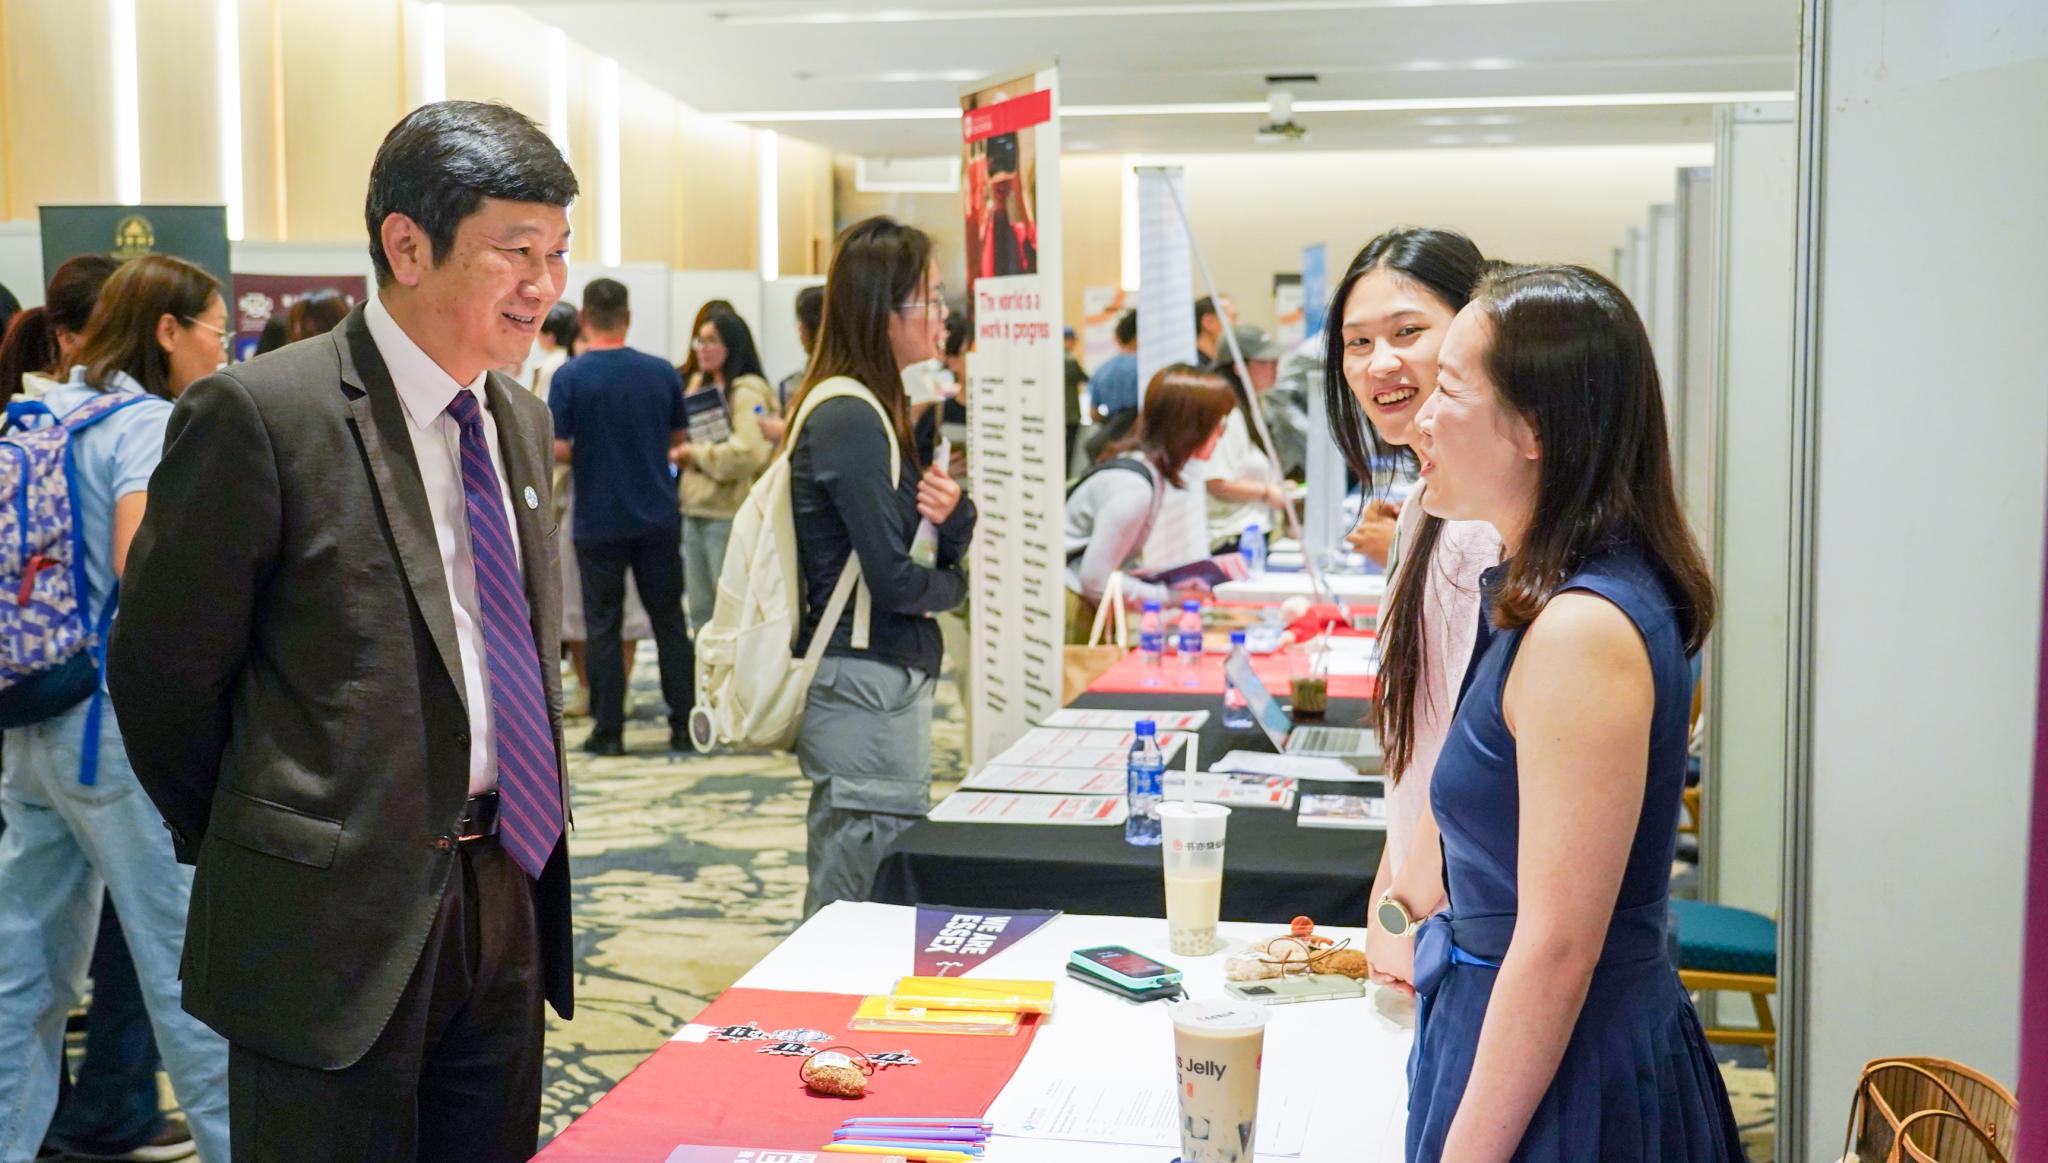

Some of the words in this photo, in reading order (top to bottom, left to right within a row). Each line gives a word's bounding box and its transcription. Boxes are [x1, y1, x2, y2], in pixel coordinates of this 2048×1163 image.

[925, 914, 983, 953] ESSEX
[977, 915, 1012, 933] WE
[960, 932, 997, 955] ARE
[1185, 1058, 1227, 1081] Jelly
